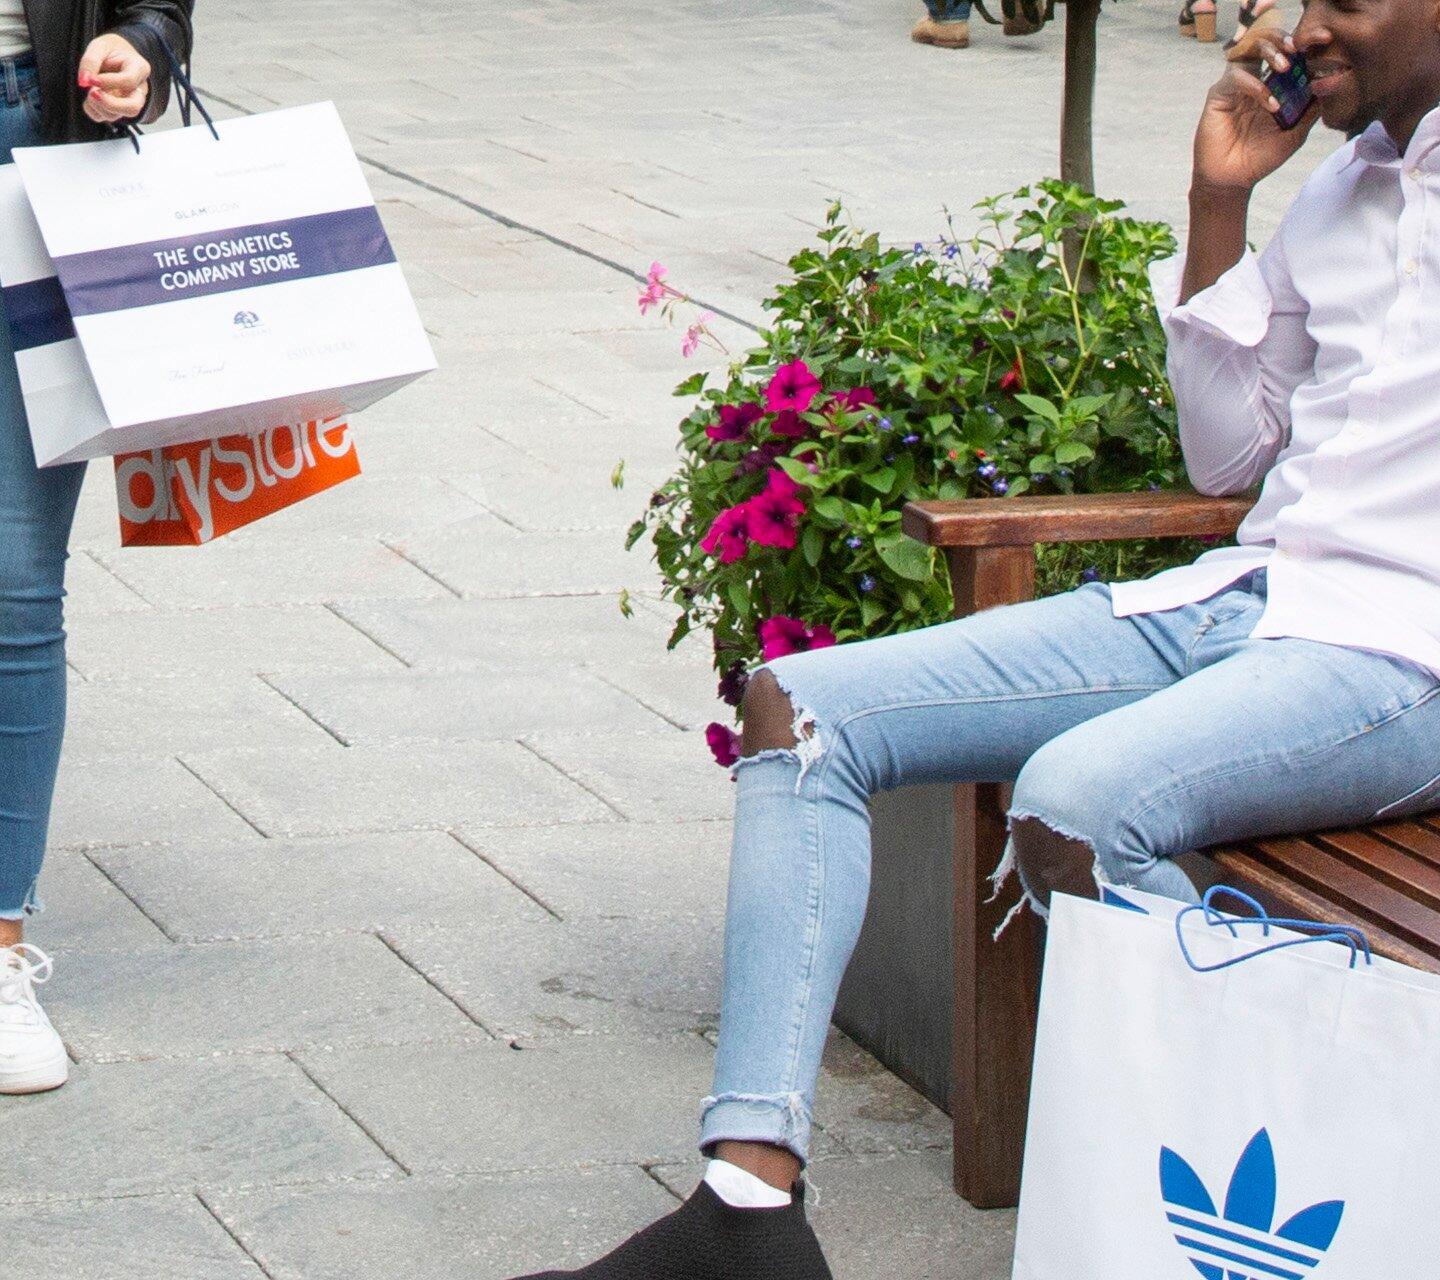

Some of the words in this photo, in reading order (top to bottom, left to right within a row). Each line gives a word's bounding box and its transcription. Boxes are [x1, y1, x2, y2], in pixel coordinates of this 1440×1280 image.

[153, 247, 189, 269] THE
[193, 231, 293, 264] COSMETICS
[160, 258, 247, 290] COMPANY
[250, 251, 301, 276] STORE
